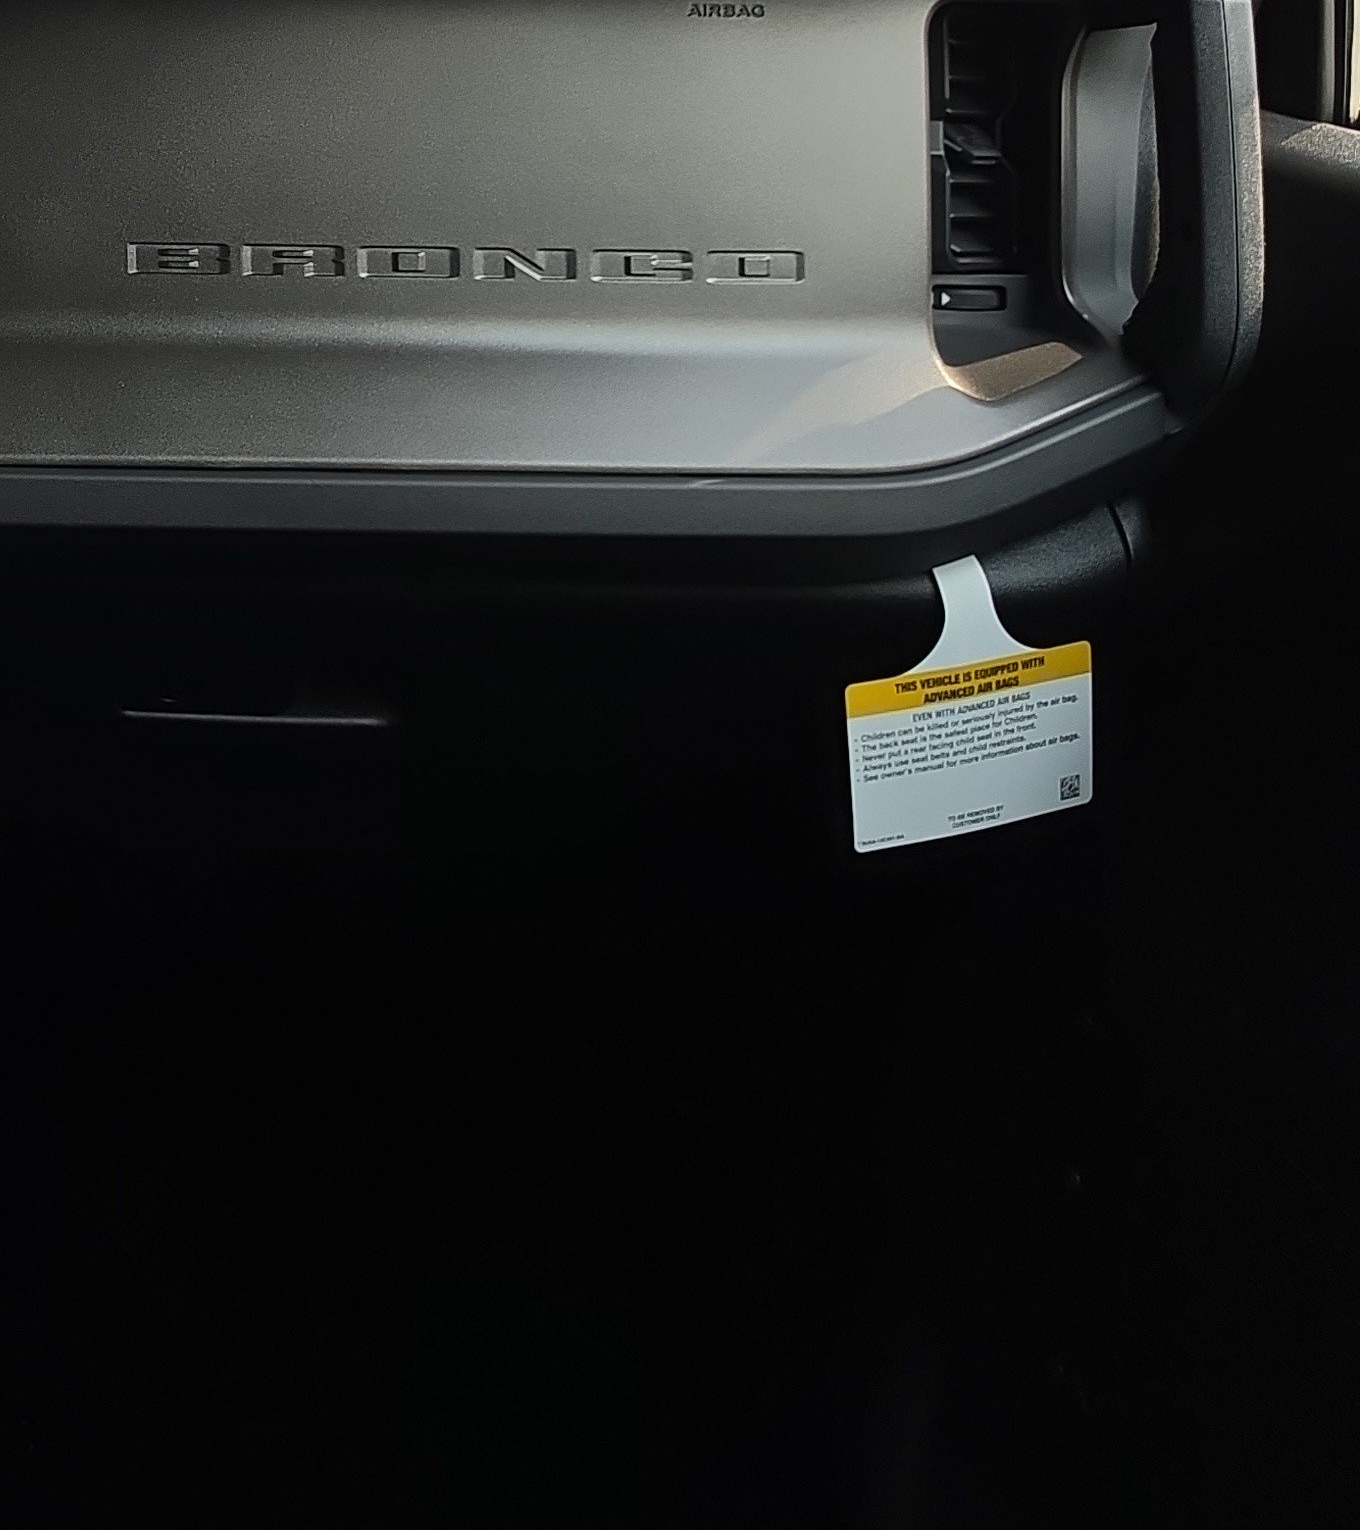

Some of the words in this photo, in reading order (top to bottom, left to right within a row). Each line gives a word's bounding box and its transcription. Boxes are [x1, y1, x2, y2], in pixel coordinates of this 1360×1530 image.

[686, 2, 766, 19] AIRBAG
[126, 241, 806, 286] BRONCO
[894, 683, 917, 695] THIS
[920, 674, 960, 691] VEHICLE
[963, 671, 972, 682] IS
[974, 661, 1018, 680] EQUIPPED
[1021, 656, 1045, 671] WITH
[923, 685, 975, 704] ADVANCED
[977, 682, 994, 696] AIR
[996, 676, 1019, 691] BAGS
[912, 710, 932, 722] EVEN
[935, 707, 955, 718] WITH
[957, 699, 994, 714] ADVANCED
[997, 696, 1009, 705] AIR
[1011, 691, 1030, 702] BAGS
